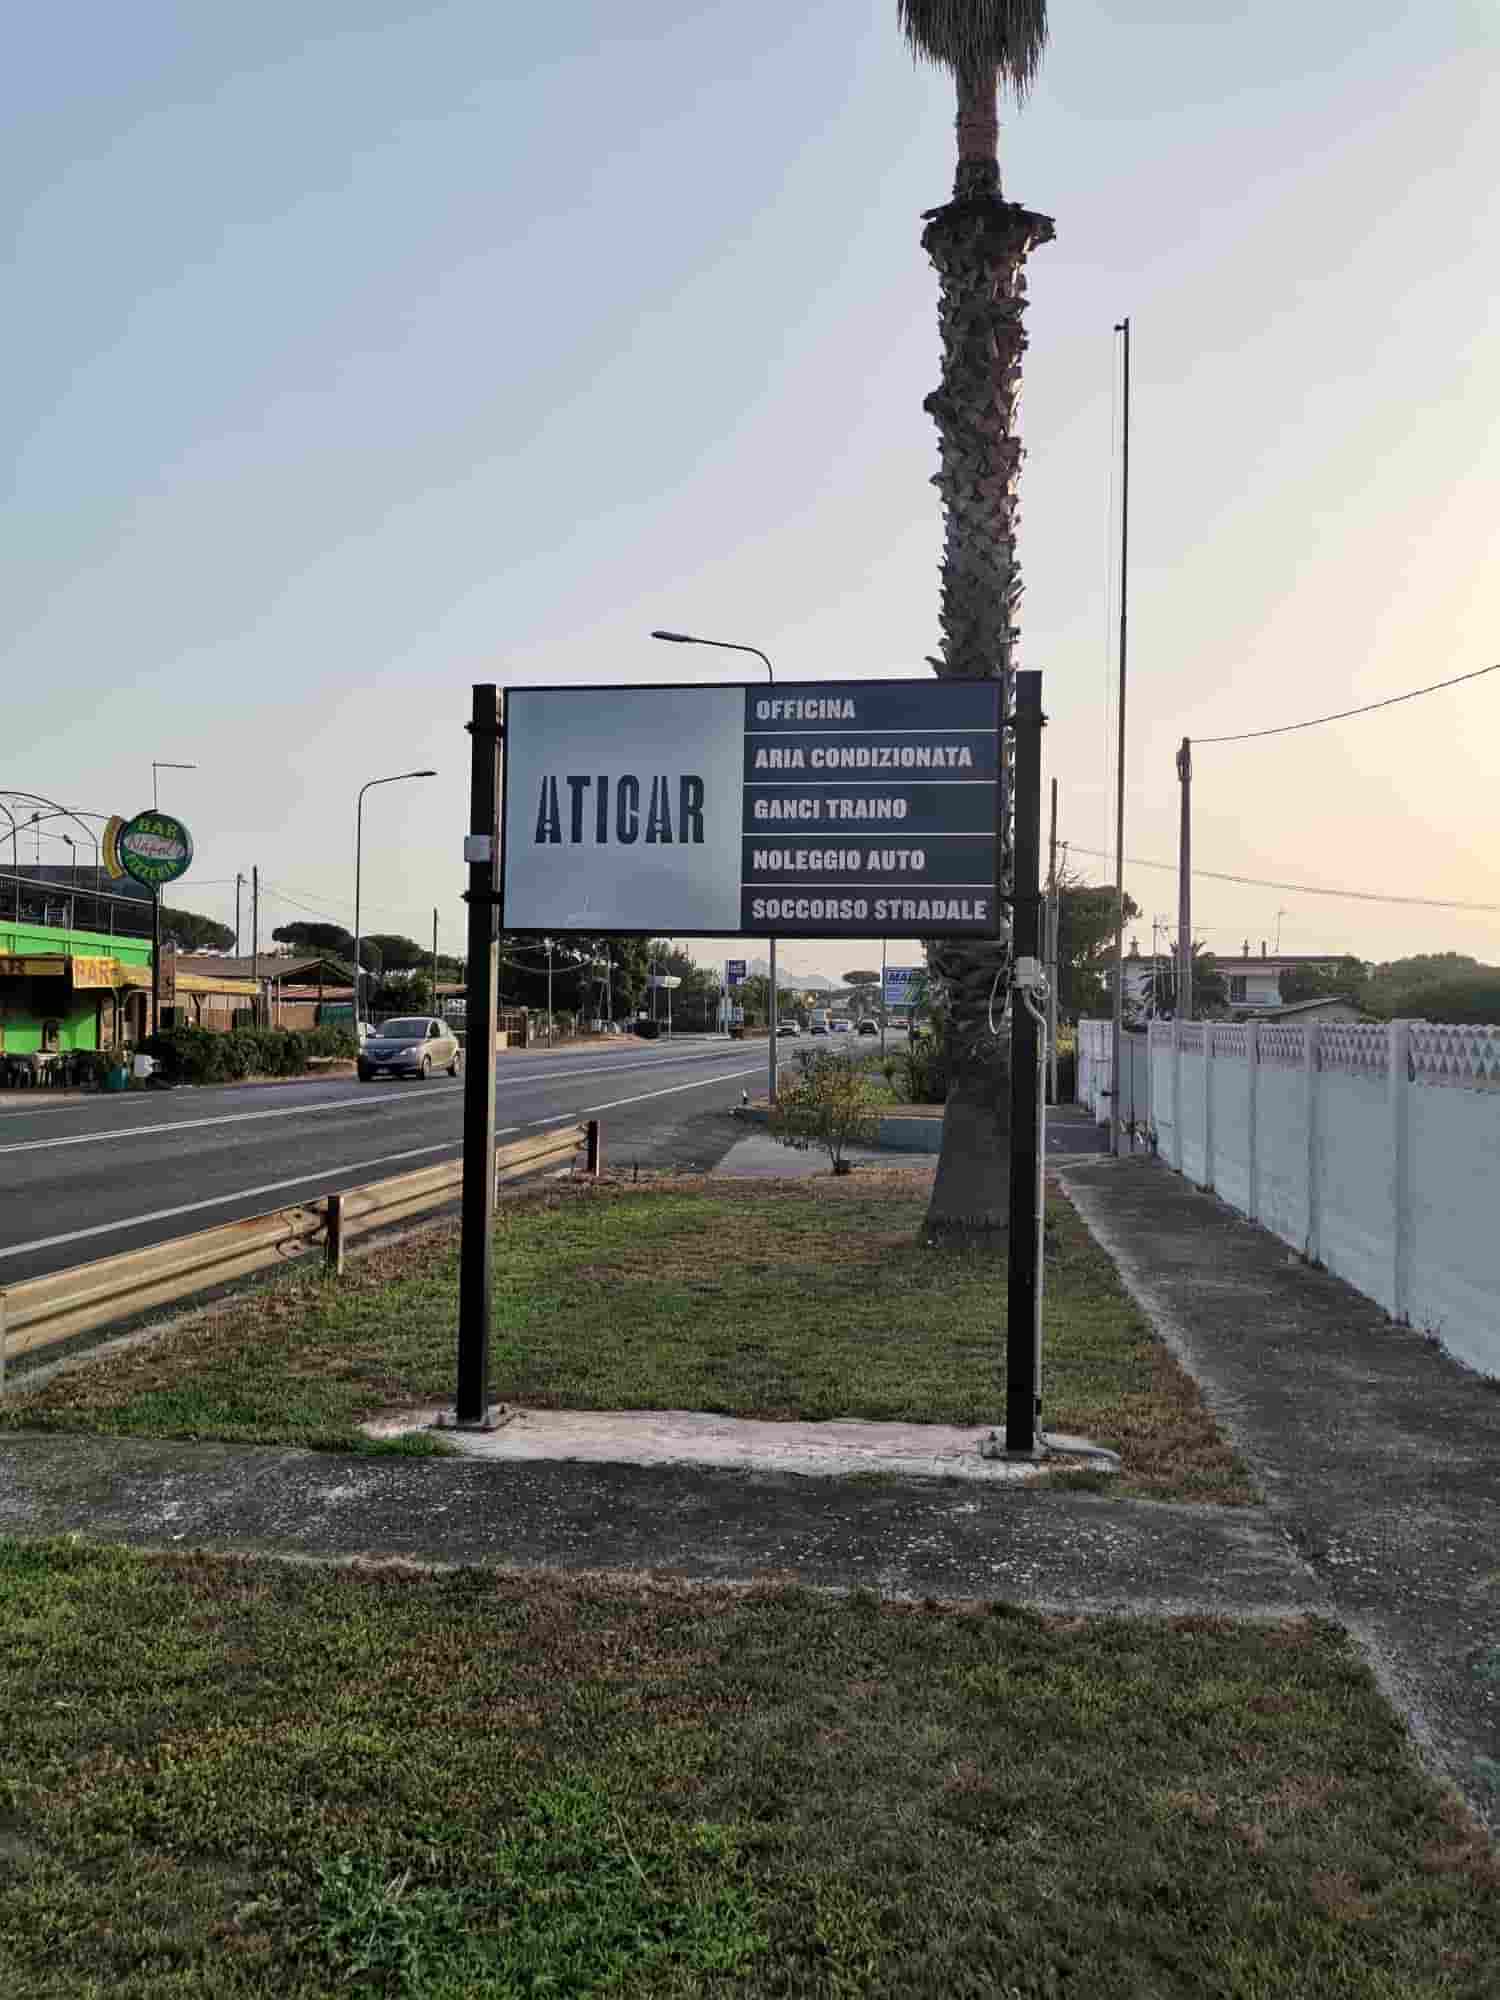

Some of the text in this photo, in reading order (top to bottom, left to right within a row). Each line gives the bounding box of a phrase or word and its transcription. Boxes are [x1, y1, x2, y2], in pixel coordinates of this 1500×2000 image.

[756, 699, 856, 721] OFFICINA
[754, 747, 973, 770] ARIA CONDIZIONATA
[535, 775, 705, 845] ATICAR
[754, 798, 908, 820] GANCI TRAINO
[138, 817, 178, 839] BAR
[753, 849, 927, 871] NOLEGGIO AUTO
[752, 898, 988, 921] SOCCORSO STRADALE
